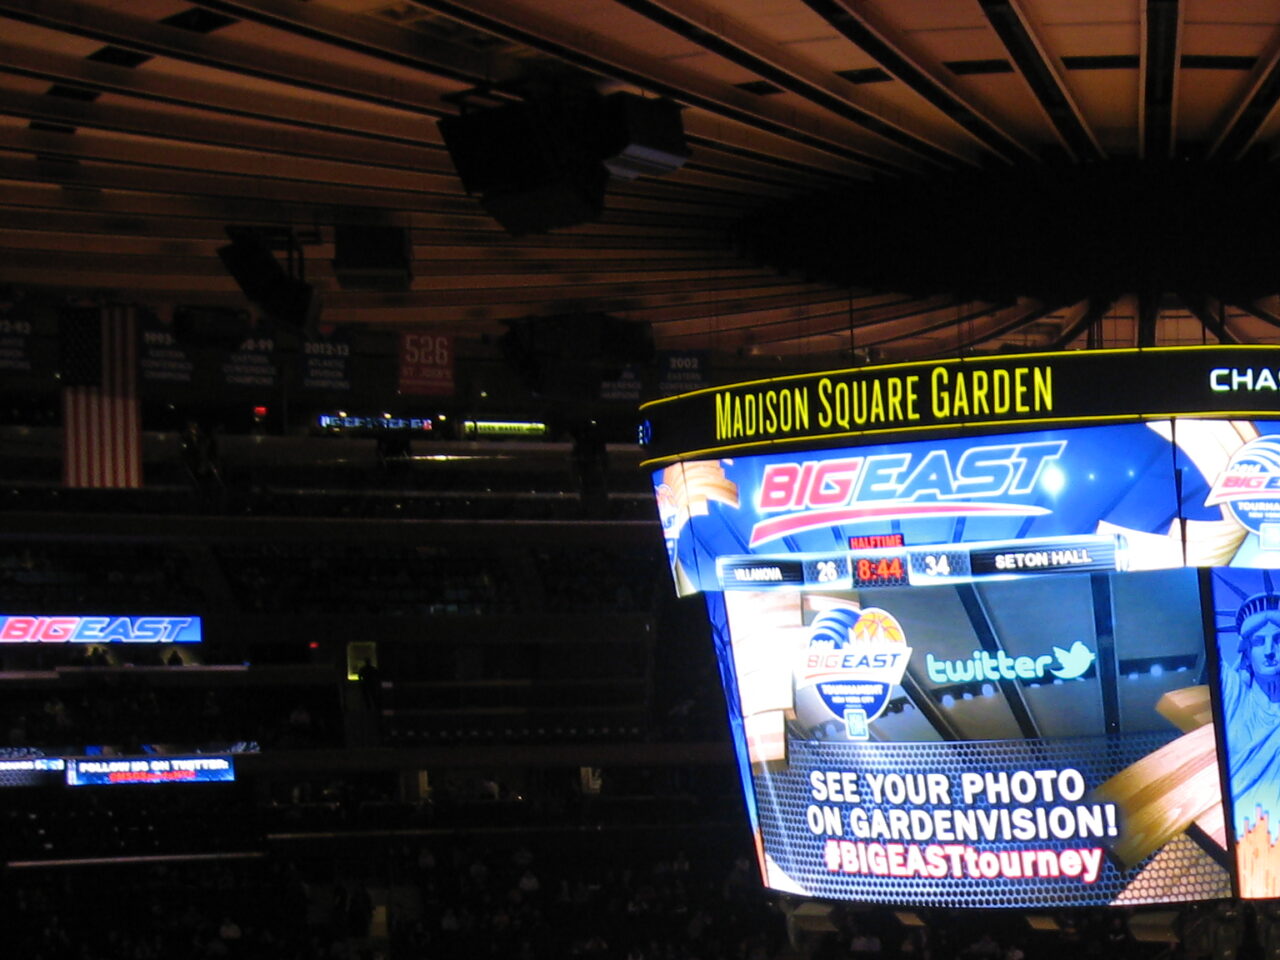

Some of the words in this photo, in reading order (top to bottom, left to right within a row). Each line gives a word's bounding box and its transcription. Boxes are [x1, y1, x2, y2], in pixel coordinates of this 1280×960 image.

[405, 335, 449, 366] 526
[716, 386, 809, 441] MADISON
[818, 375, 920, 430] SQUARE
[931, 366, 1054, 419] GARDEN
[850, 535, 902, 549] HALFTIME
[857, 558, 903, 580] 8:44
[924, 554, 951, 576] 34
[995, 552, 1049, 569] SETON
[1052, 548, 1093, 565] HALL
[733, 566, 783, 582] VILLANOVA
[817, 561, 838, 582] 26
[926, 650, 1053, 683] twitter
[79, 761, 130, 773] FOLLOW
[810, 770, 860, 803] SEE
[864, 773, 951, 805] YOUR
[961, 769, 1085, 805] PHOTO
[806, 805, 843, 836] ON
[849, 804, 1118, 841] GARDENVISION!
[825, 840, 1103, 884] #BIGEASTtourney
